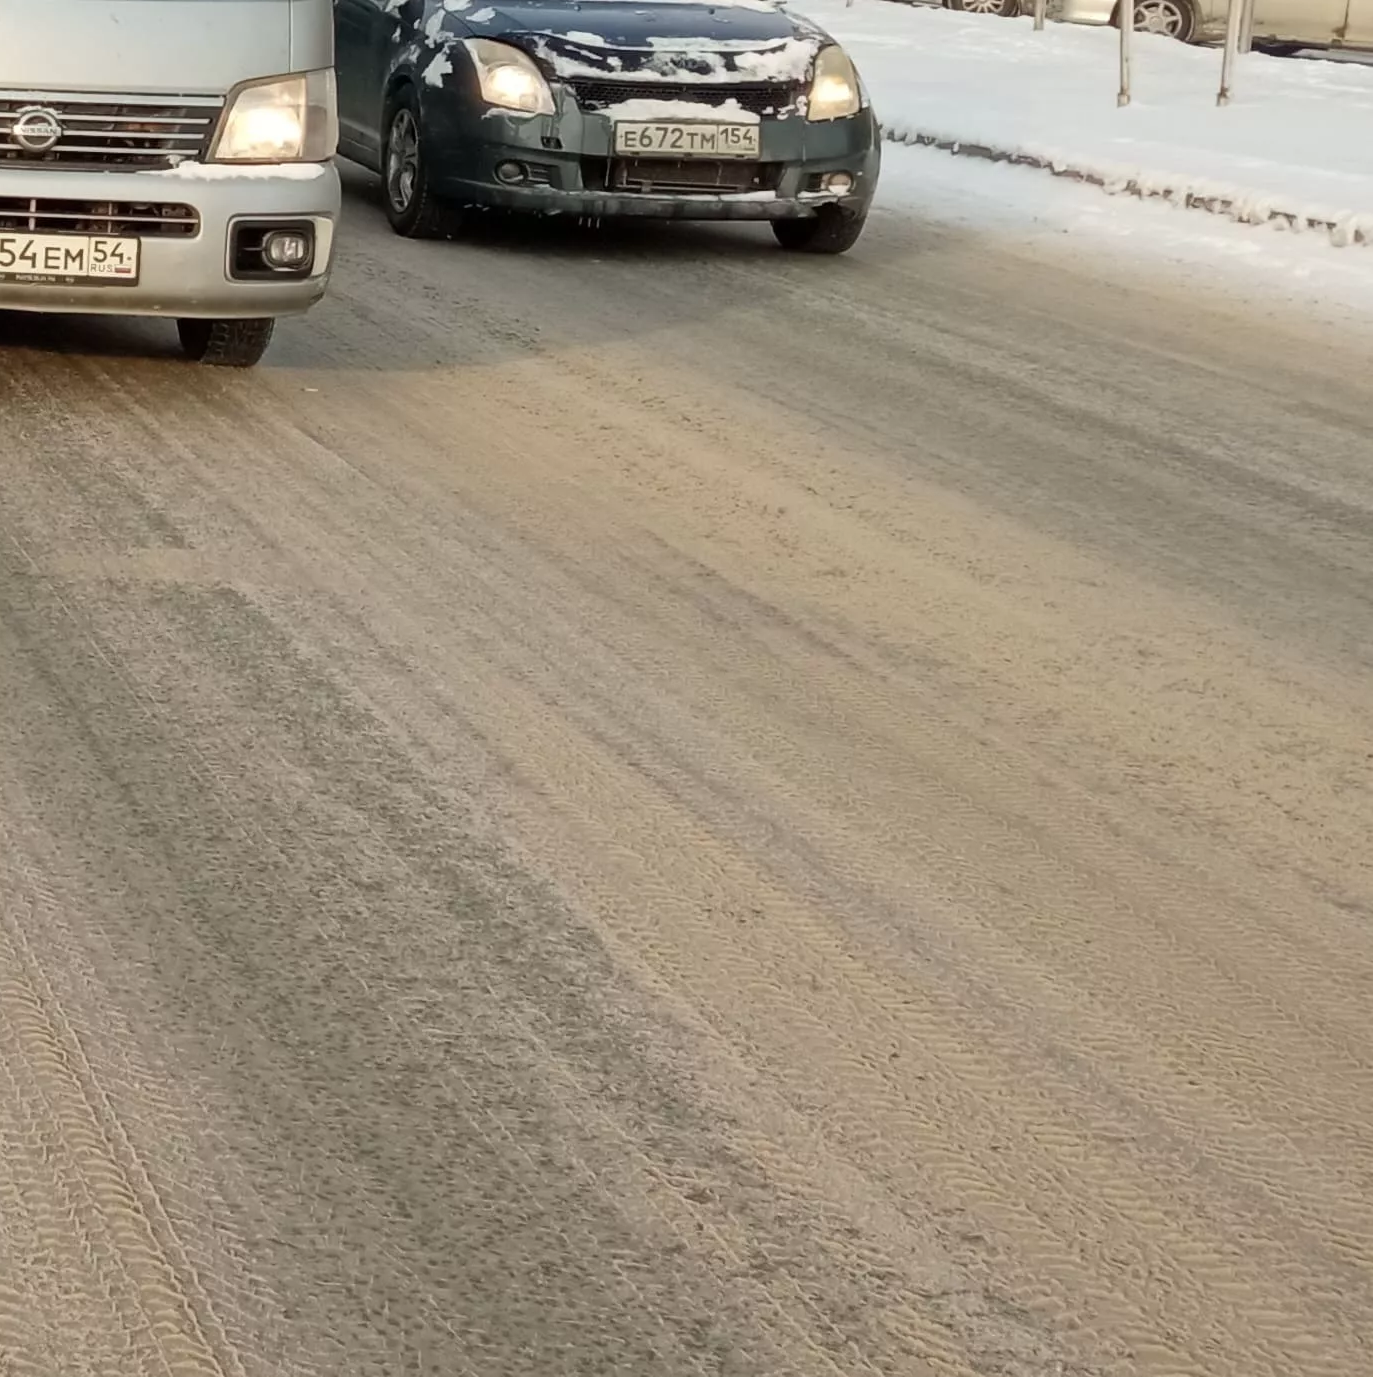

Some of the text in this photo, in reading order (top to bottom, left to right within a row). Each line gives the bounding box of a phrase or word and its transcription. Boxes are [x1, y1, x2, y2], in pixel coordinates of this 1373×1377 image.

[720, 128, 752, 144] 154
[93, 241, 124, 265] 54
[90, 263, 113, 273] RUS
